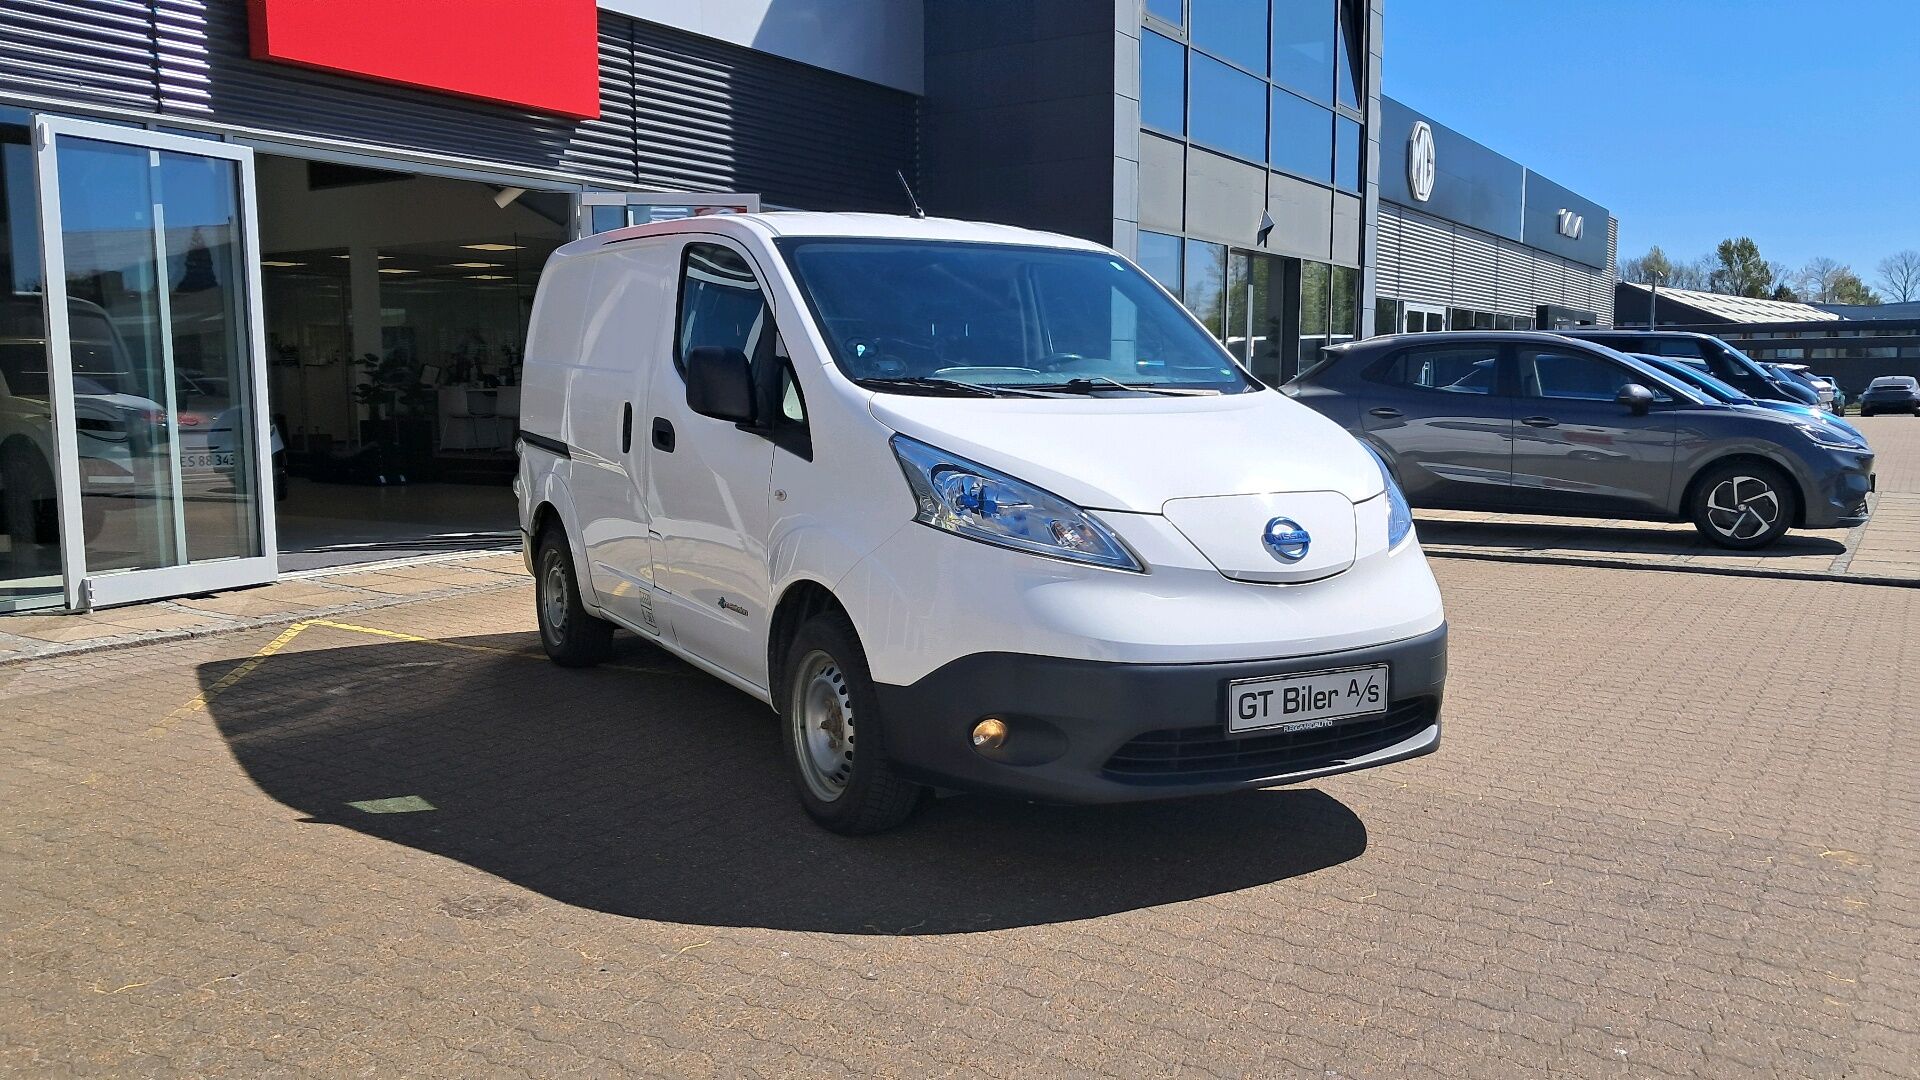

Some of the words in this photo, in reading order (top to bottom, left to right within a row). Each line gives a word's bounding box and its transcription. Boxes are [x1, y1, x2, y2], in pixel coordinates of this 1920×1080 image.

[199, 455, 213, 467] 88
[1238, 690, 1274, 720] GT
[1282, 684, 1339, 715] Biler
